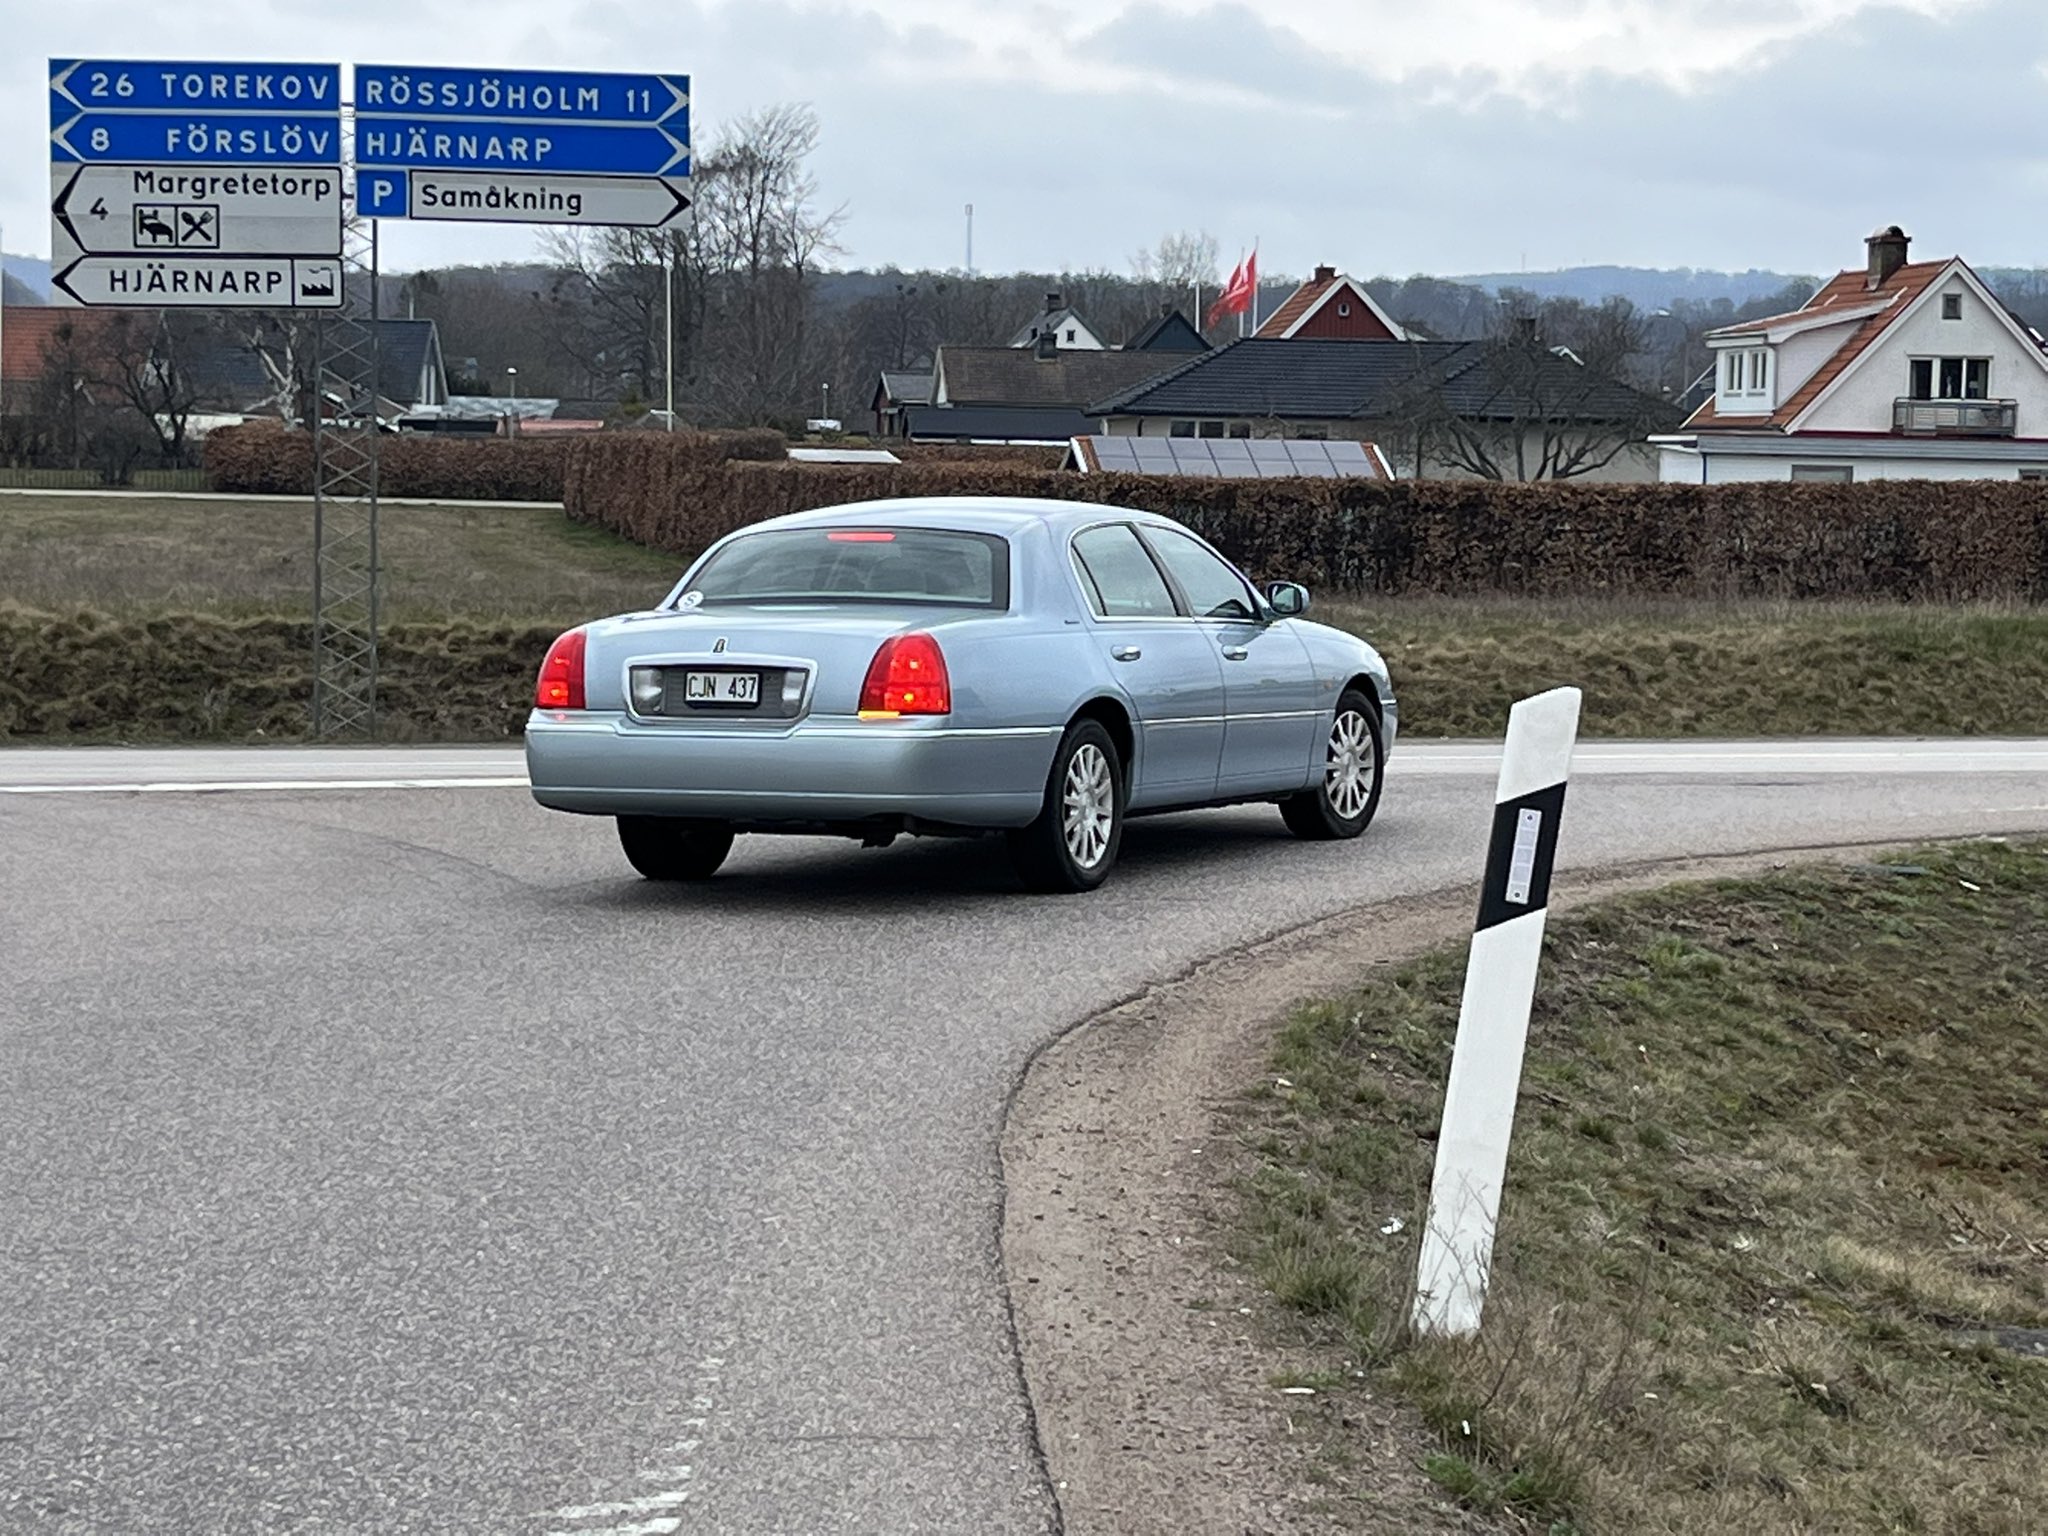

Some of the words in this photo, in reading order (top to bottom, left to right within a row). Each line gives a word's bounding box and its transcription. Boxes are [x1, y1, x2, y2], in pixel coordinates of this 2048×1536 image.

[90, 73, 135, 98] 26
[161, 74, 329, 100] TOREKOV
[366, 75, 599, 112] RÖSSJÖHOLM
[626, 89, 650, 113] 11
[90, 127, 110, 152] 8
[166, 123, 330, 154] FÖRSLÖV
[366, 127, 552, 162] HJÄRNARP
[133, 170, 331, 202] Margretetorp
[373, 180, 394, 208] P
[421, 184, 582, 216] Samåkning
[90, 197, 109, 221] 4
[109, 262, 282, 294] HJÄRNARP
[688, 676, 716, 698] CJN
[728, 677, 757, 699] 437
